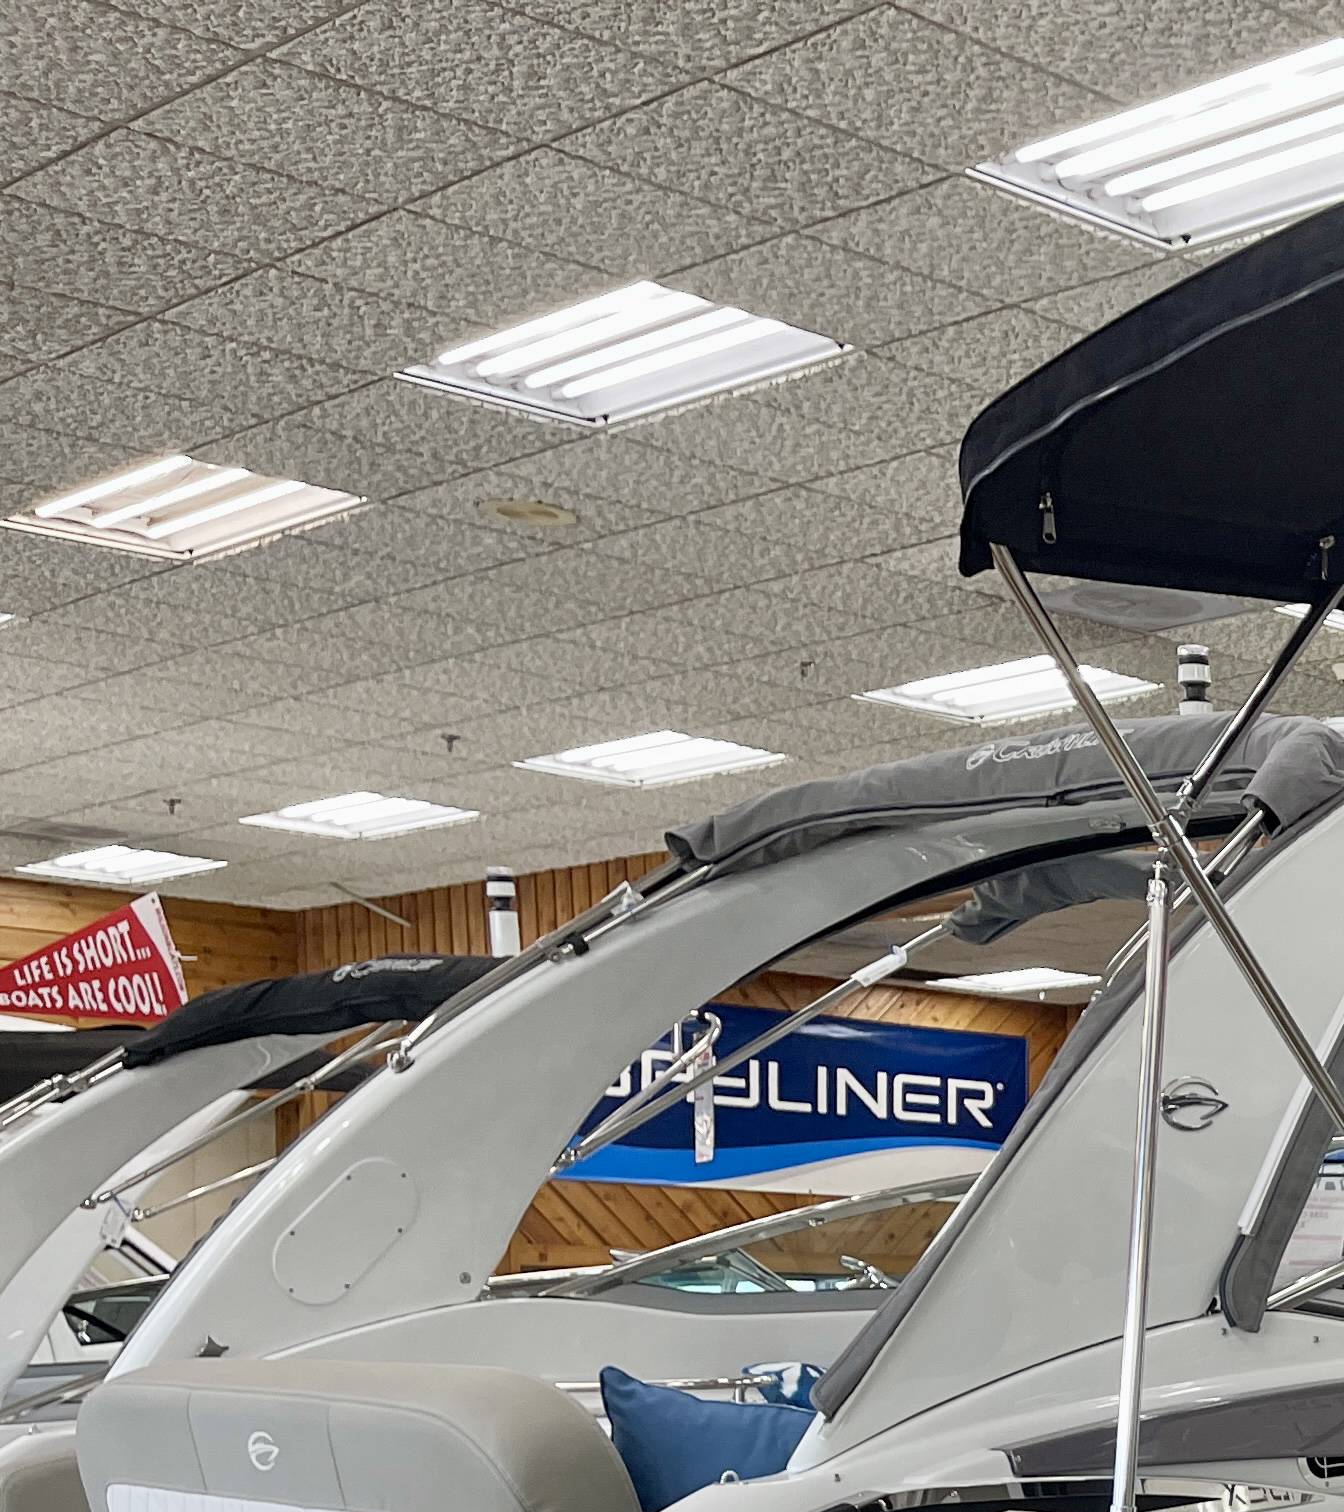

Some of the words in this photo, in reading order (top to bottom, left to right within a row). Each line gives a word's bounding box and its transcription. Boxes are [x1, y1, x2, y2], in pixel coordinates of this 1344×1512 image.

[14, 955, 54, 986] LIFE
[53, 946, 74, 977] IS
[72, 919, 151, 973] SHORT...
[67, 979, 109, 1012] ARE
[108, 971, 168, 1016] COOL!
